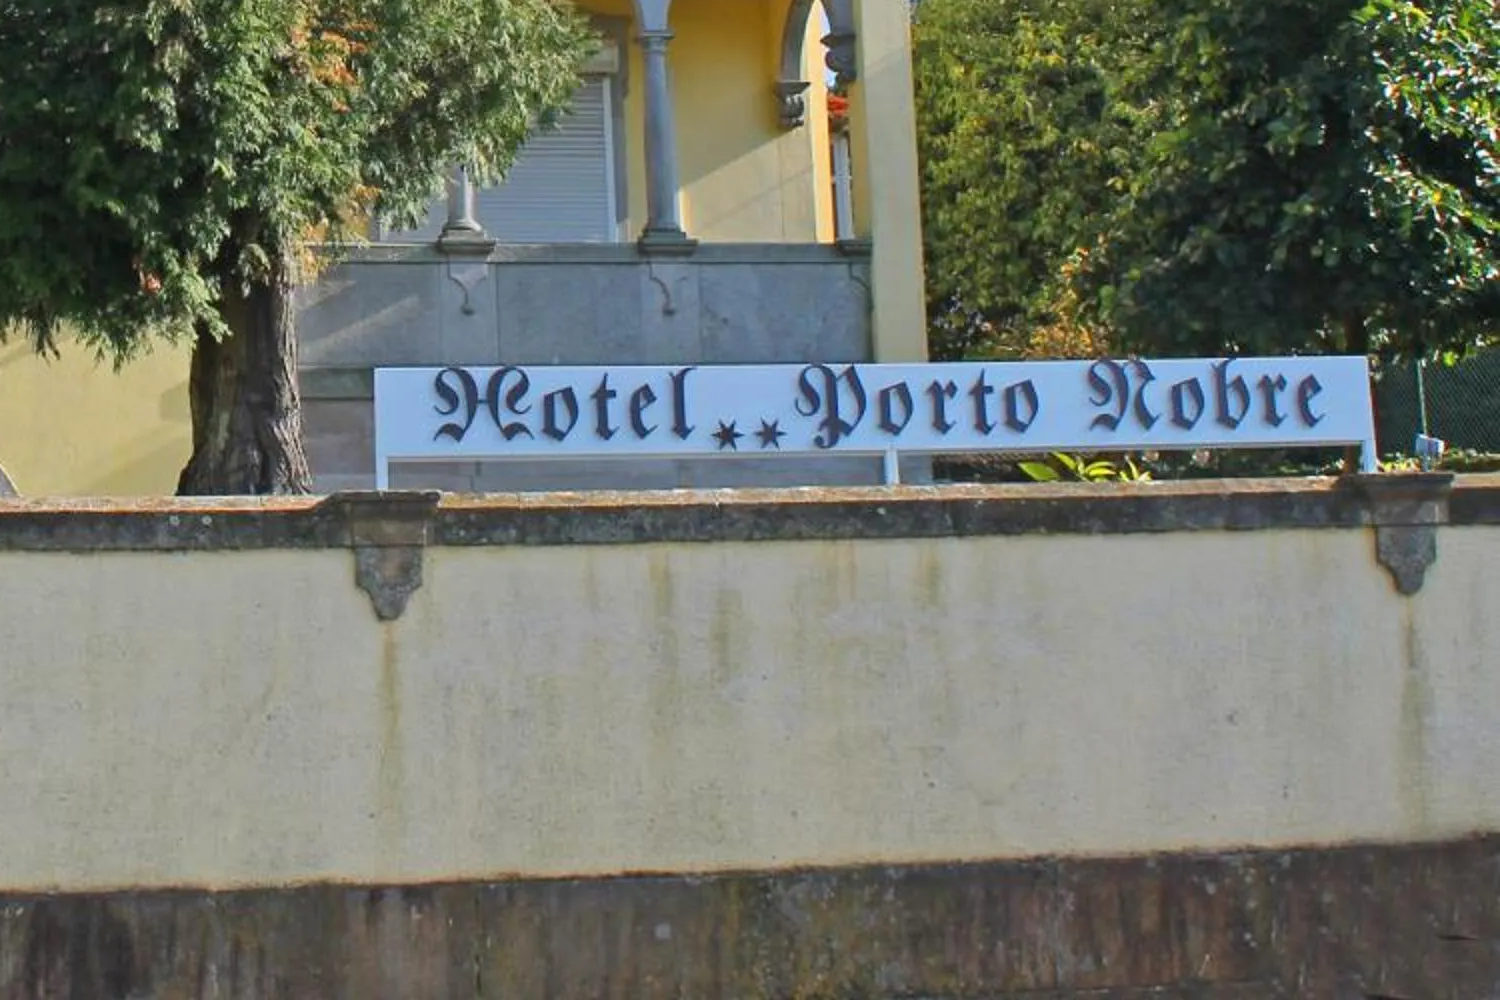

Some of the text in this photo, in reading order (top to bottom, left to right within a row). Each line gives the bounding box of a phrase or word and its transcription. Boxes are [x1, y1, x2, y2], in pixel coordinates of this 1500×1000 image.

[433, 357, 1326, 449] Hotel Porto Nobre
